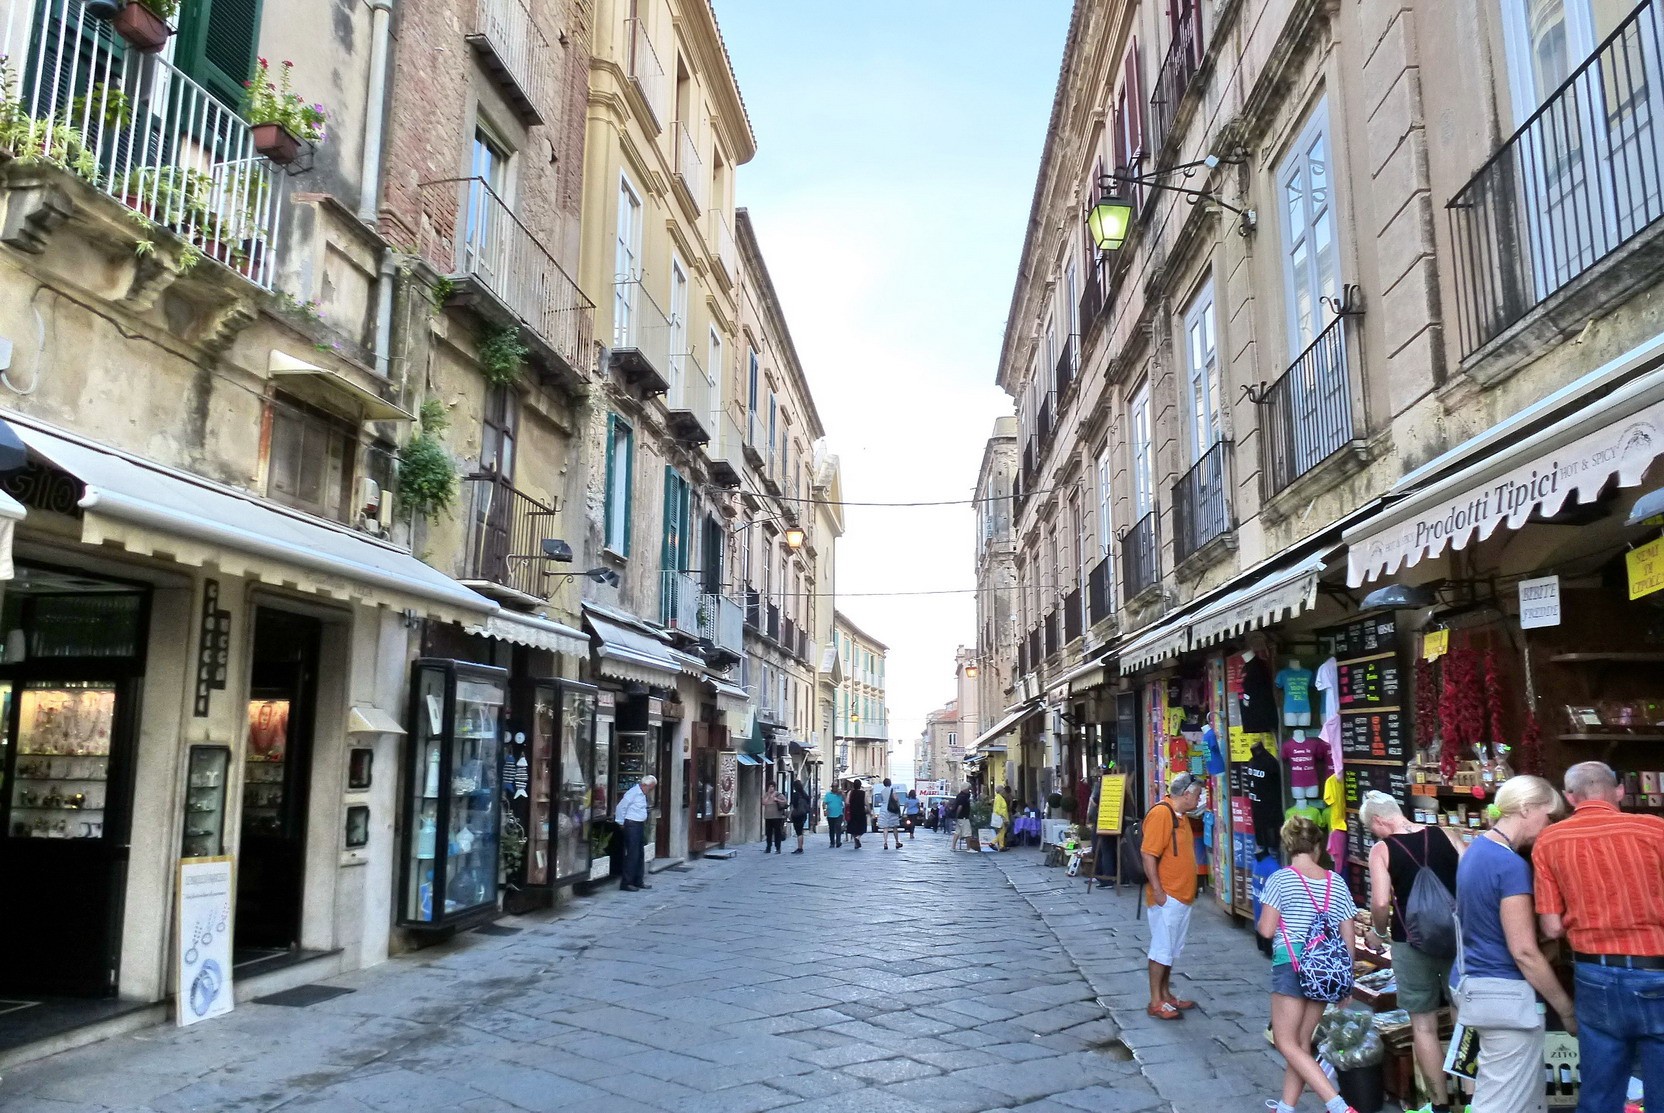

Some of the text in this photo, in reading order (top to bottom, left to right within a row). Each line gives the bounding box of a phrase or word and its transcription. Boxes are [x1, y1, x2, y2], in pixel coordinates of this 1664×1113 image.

[1415, 491, 1489, 548] Prodotti
[1494, 461, 1558, 516] Tipici
[1559, 461, 1578, 480] HOT
[1581, 458, 1589, 471] &
[1591, 446, 1617, 467] SPICY
[1550, 1051, 1577, 1059] ZITO
